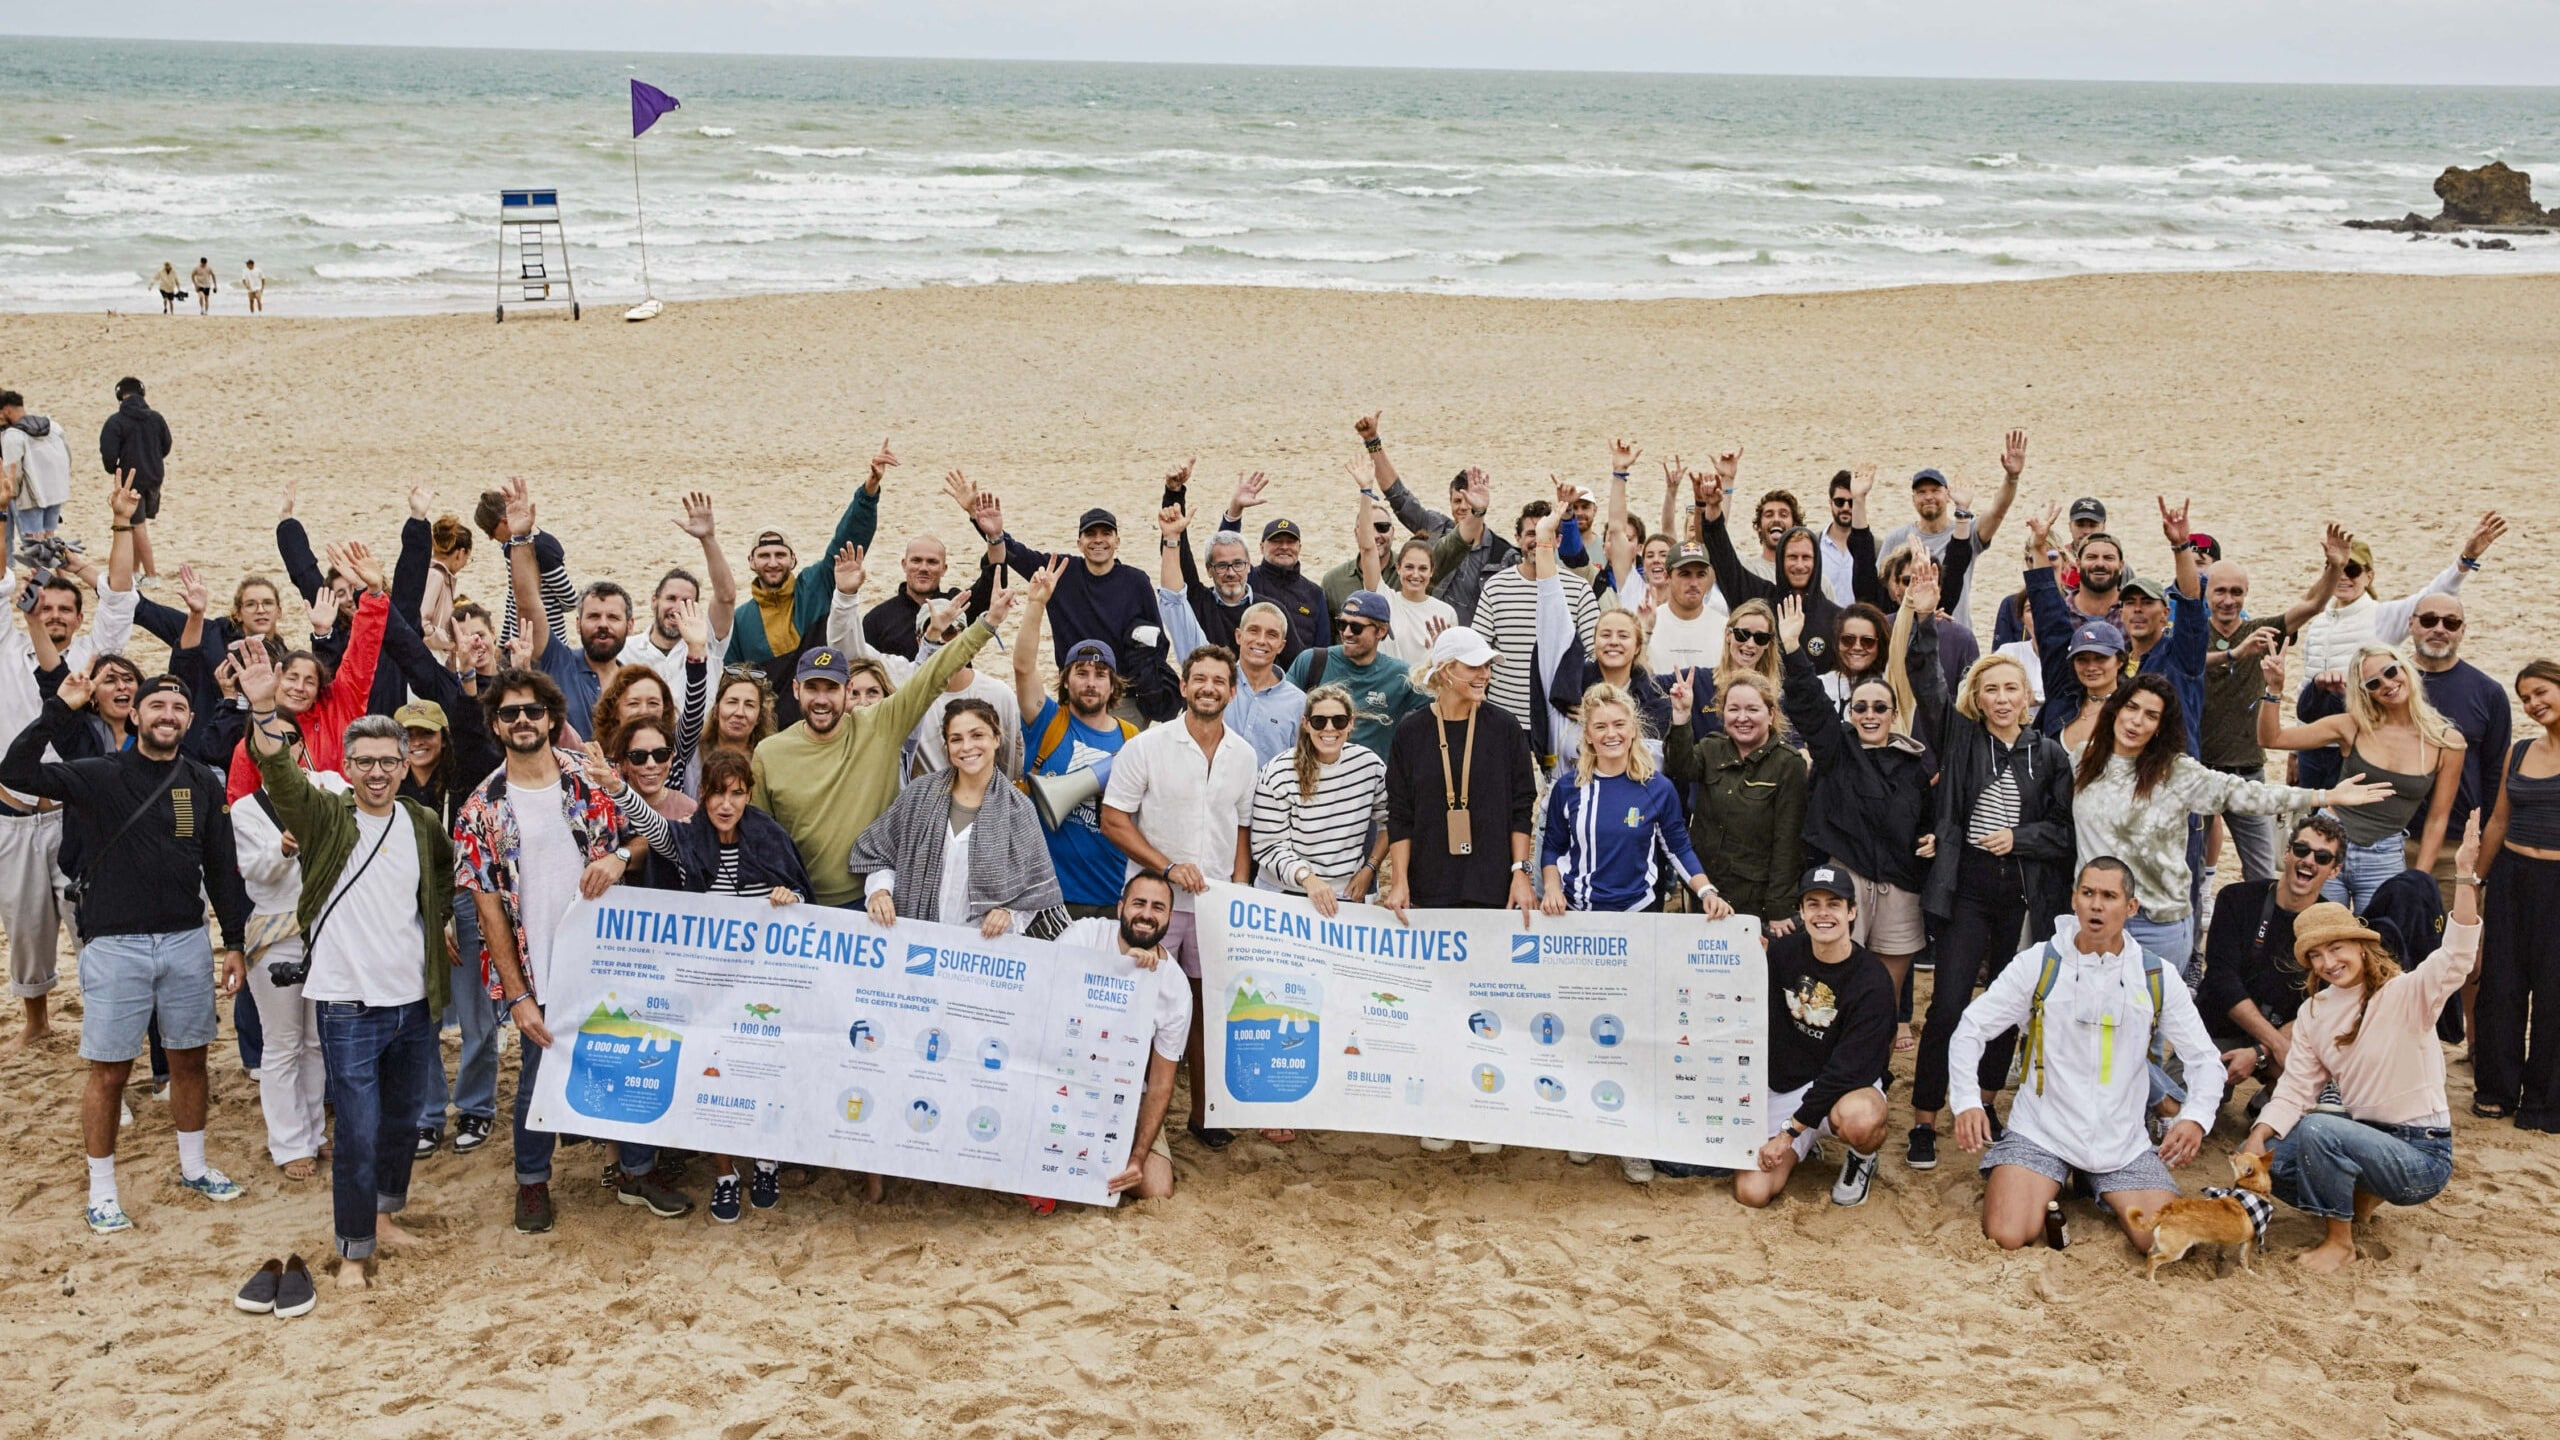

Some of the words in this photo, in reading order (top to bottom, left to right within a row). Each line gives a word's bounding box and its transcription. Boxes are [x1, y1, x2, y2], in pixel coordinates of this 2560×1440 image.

[596, 908, 757, 952] INITIATIVES
[765, 921, 887, 968] OCÉANES
[1229, 900, 1311, 940] OCEAN
[1320, 920, 1468, 962] INITIATIVES
[1543, 935, 1628, 956] SURFRIDER
[1697, 939, 1728, 951] OCEAN
[939, 950, 1026, 981] SURFRIDER
[1543, 957, 1593, 966] FOUNDATION
[1595, 959, 1628, 967] EUROPE
[1688, 953, 1740, 966] INITIATIVES
[634, 963, 659, 971] TERRE,
[937, 971, 989, 986] FOUNDATION
[990, 981, 1024, 992] EUROPE
[1084, 972, 1135, 991] INITIATIVES
[1285, 982, 1306, 995] 80%
[647, 996, 669, 1010] 80%
[856, 988, 895, 999] BOUTEILLE
[897, 993, 939, 1005] PLASTIQUE,
[1088, 988, 1128, 1005] OCÉANES
[871, 999, 897, 1008] GESTES
[900, 1002, 930, 1012] SIMPLES
[1363, 1005, 1408, 1020] 1,000,000
[732, 1022, 737, 1032] 1
[740, 1023, 759, 1034] 000
[762, 1025, 781, 1037] 000
[587, 1041, 593, 1050] 8
[594, 1042, 611, 1052] 000
[613, 1043, 630, 1054] 000
[1271, 1058, 1306, 1069] 269,000
[624, 1076, 641, 1087] 269
[643, 1078, 660, 1090] 000
[1347, 1070, 1358, 1081] 89
[1360, 1072, 1391, 1084] BILLION
[697, 1093, 708, 1104] 89
[711, 1095, 756, 1110] MILLIARDS
